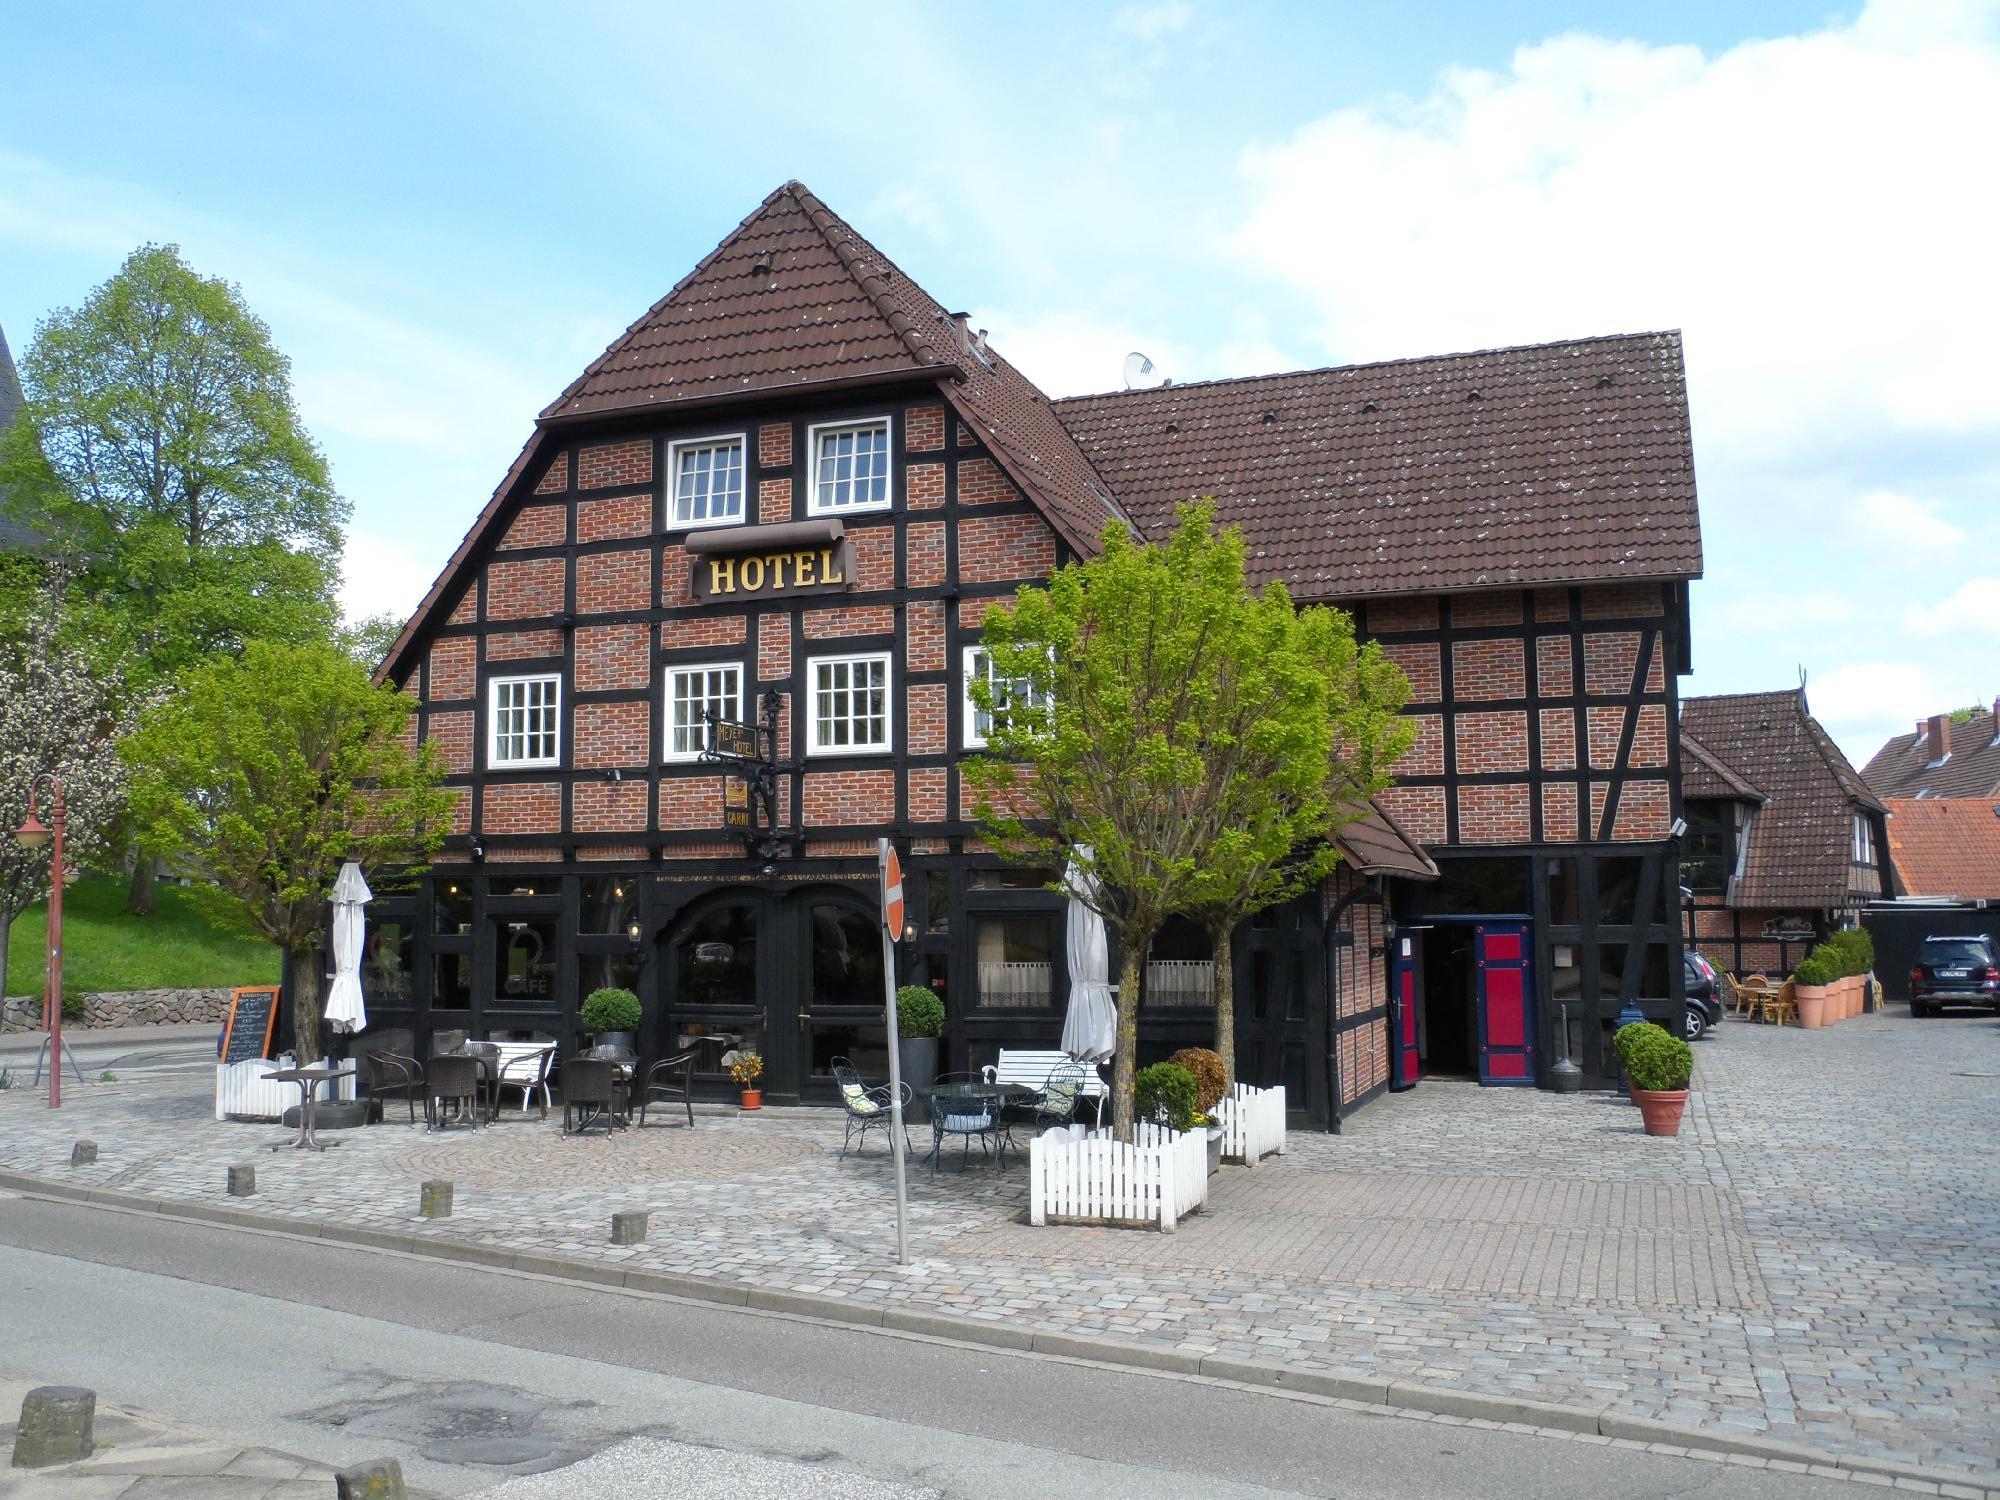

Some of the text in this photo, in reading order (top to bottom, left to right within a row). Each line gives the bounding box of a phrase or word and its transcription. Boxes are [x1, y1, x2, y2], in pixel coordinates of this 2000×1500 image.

[710, 550, 842, 594] HOTEL
[733, 740, 754, 755] HOTEL
[727, 811, 749, 826] GARNI
